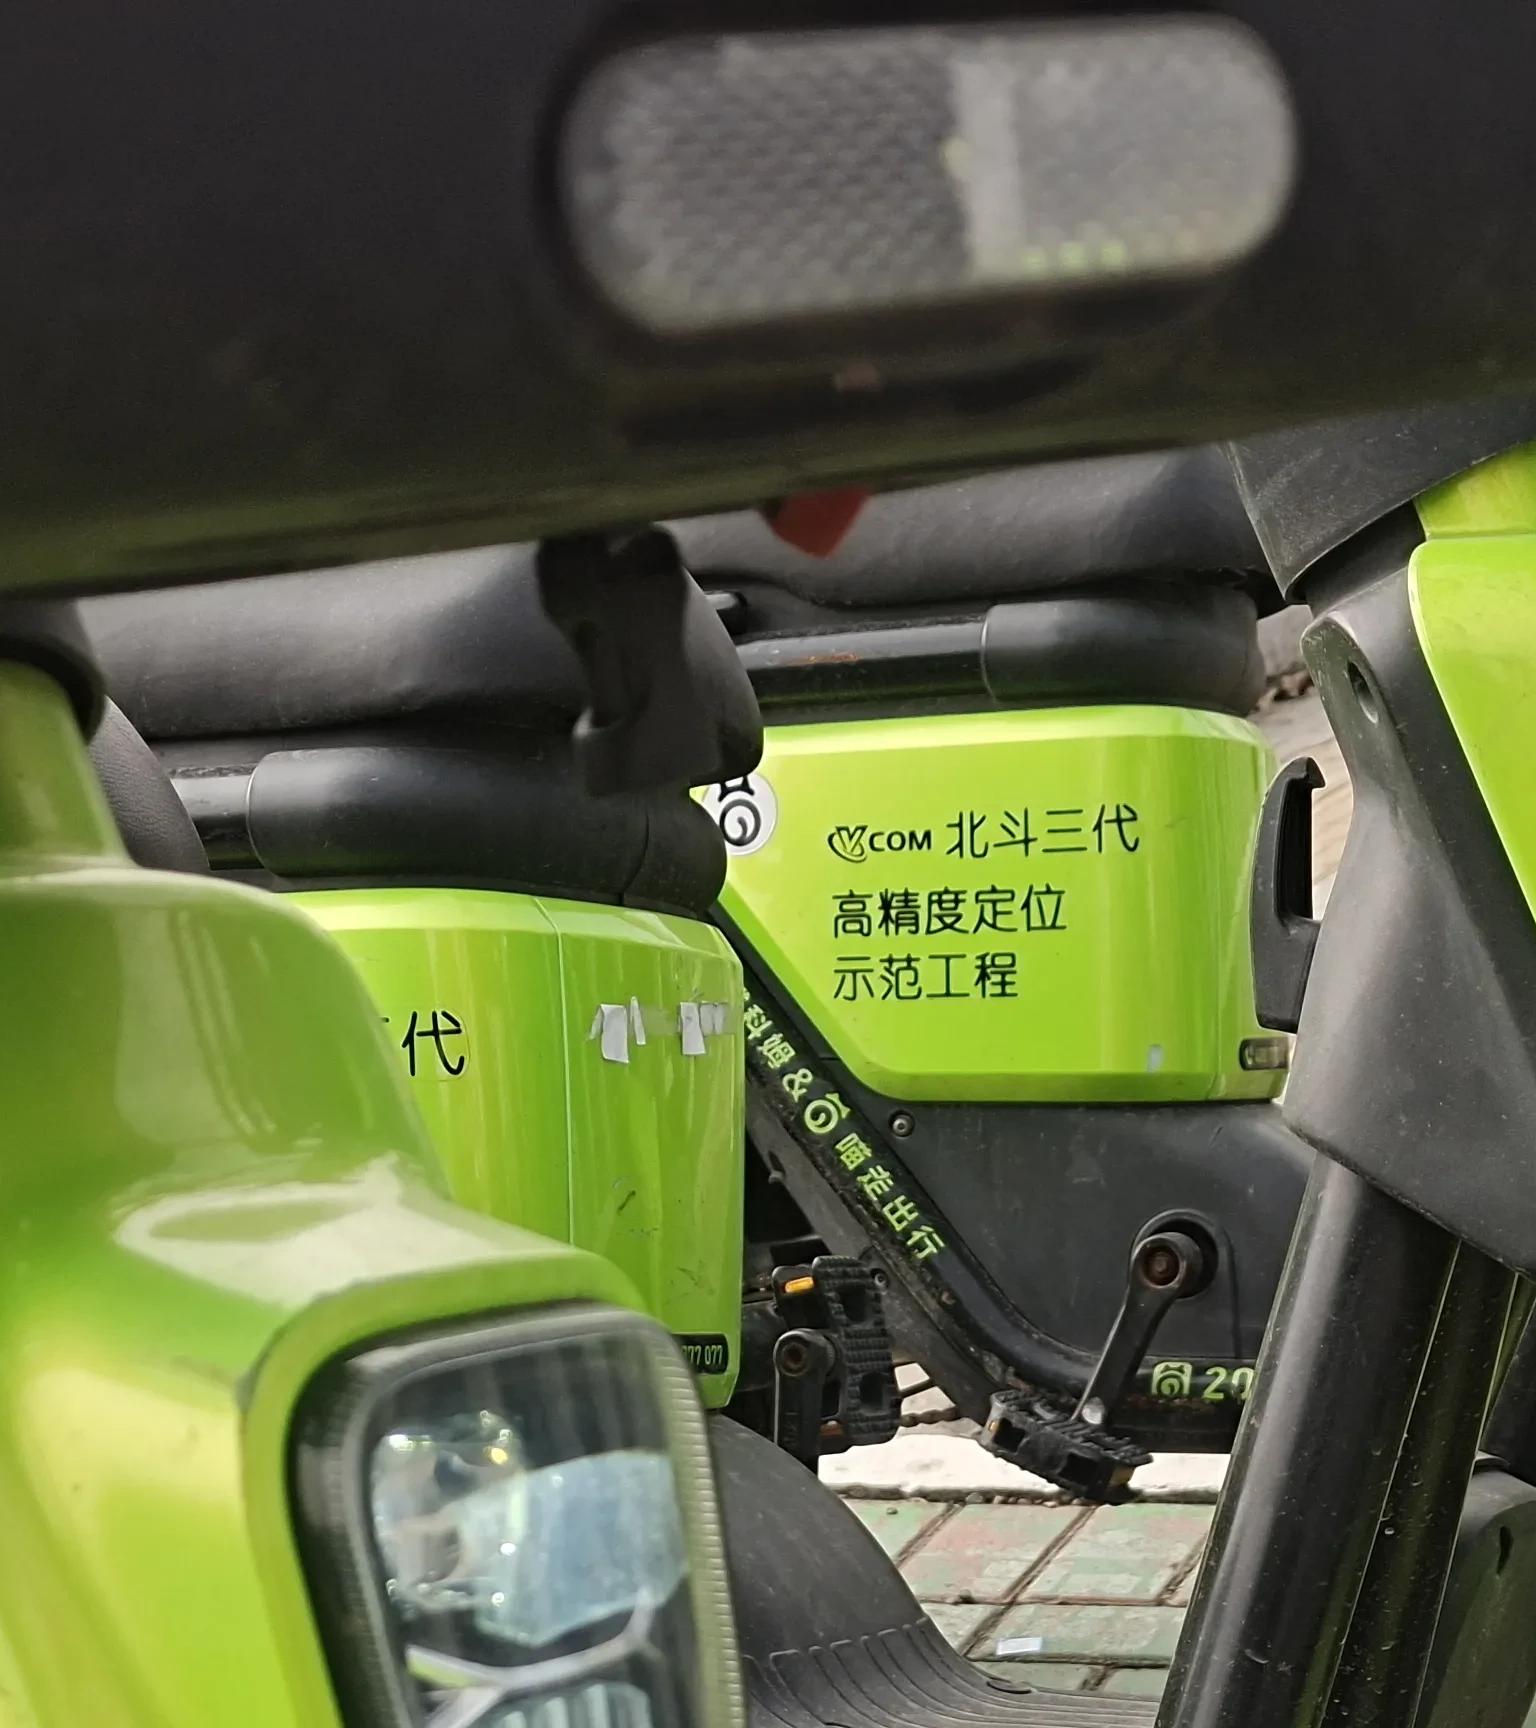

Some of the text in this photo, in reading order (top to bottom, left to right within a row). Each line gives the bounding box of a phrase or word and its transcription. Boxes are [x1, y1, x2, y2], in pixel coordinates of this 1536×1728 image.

[945, 803, 1140, 859] 北斗三代
[832, 882, 1067, 938] 高精度定位
[833, 952, 1018, 1001] 示范工程
[383, 1010, 465, 1077] 代
[743, 987, 945, 1259] 科姆 & 喵走出行
